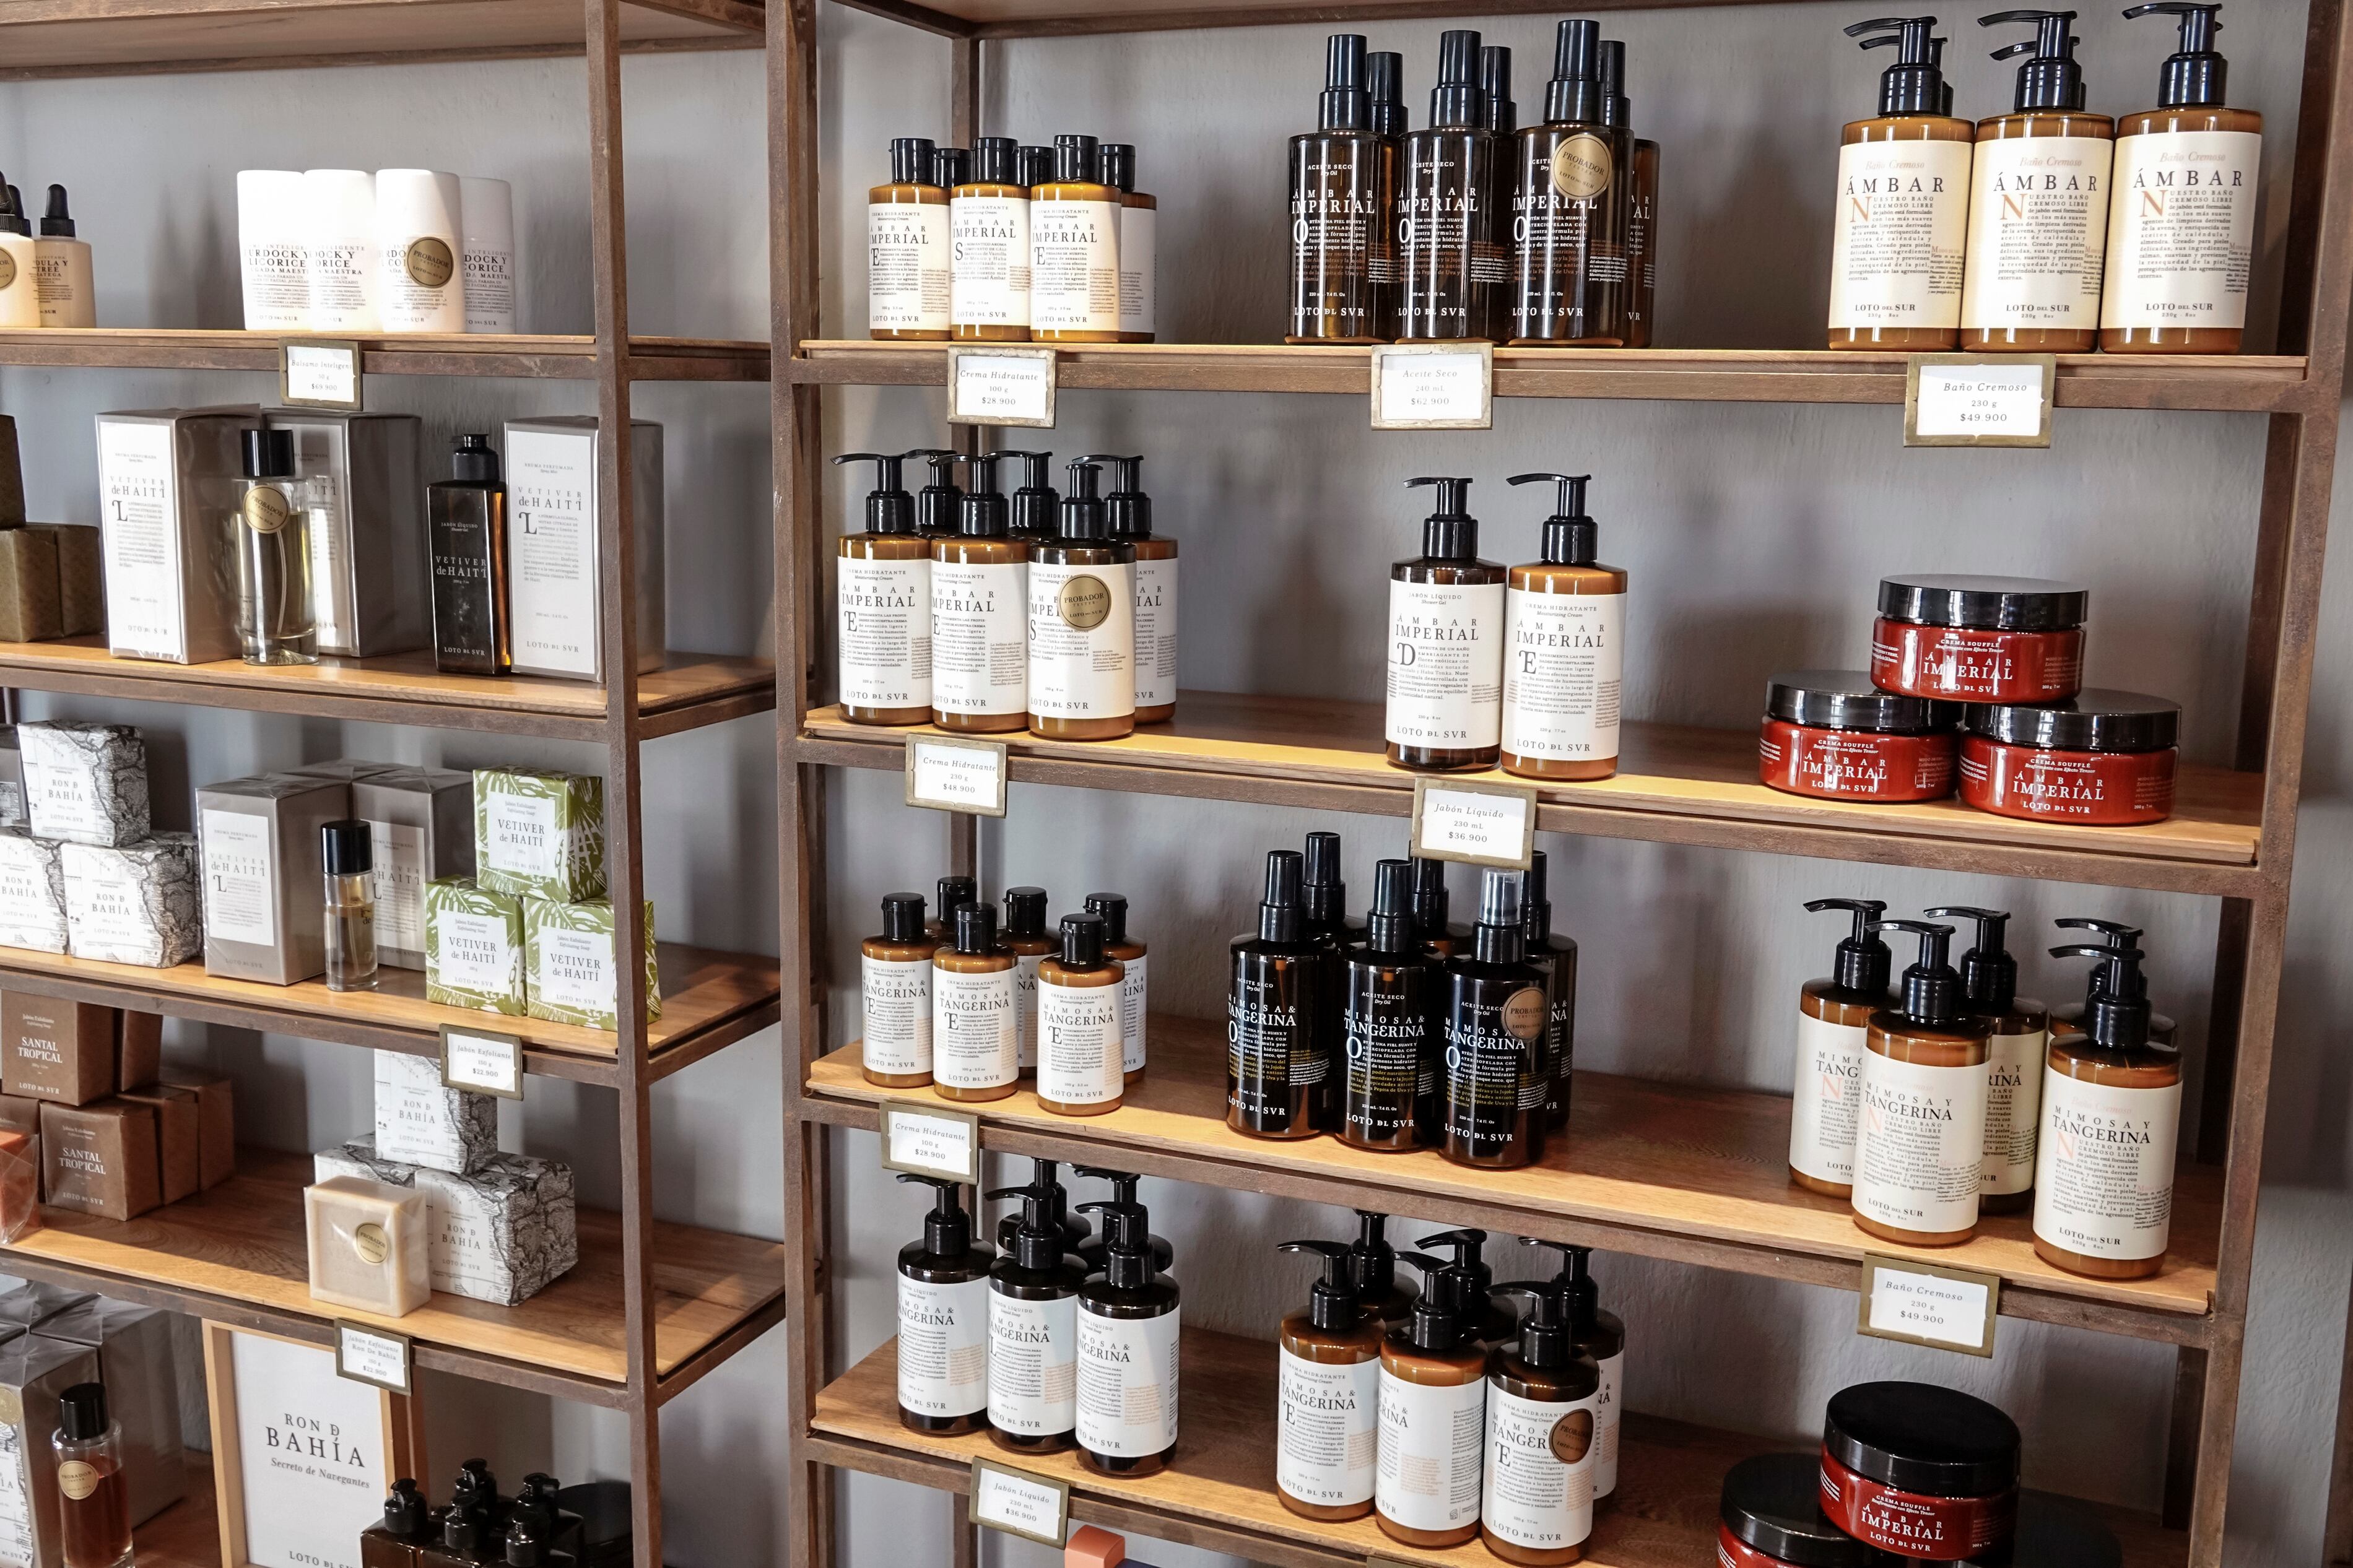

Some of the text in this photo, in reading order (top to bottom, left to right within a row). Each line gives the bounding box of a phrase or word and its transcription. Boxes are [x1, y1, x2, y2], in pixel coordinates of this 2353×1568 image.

[1562, 150, 1605, 176] PROBADOR
[2046, 157, 2082, 167] Cremoso
[2160, 151, 2225, 162] Baño Cremoso
[1889, 160, 1925, 170] Cremoso
[1846, 176, 1944, 195] ÁMBAR
[1993, 172, 2097, 192] ÁMBAR
[2133, 168, 2242, 188] ÁMBAR
[1292, 200, 1375, 214] IMPERIAL
[1398, 198, 1479, 214] IMPERIAL
[1513, 196, 1598, 212] IMPERIAL
[870, 233, 929, 245] IMPERIAL
[953, 228, 1016, 238] IMPERIAL
[1033, 232, 1097, 243] IMPERIAL
[413, 250, 450, 267] PROBADOR
[2006, 304, 2069, 312] LOTO SUR
[960, 370, 1038, 381] Crema Hidratante
[1403, 370, 1458, 378] Aceite Seco
[1944, 383, 2027, 392] Baño Cremoso
[518, 487, 581, 498] VETIVER
[436, 555, 487, 566] VETIVER
[842, 592, 916, 607] IMPERIAL
[1064, 592, 1105, 604] PROBADOR
[1396, 623, 1479, 641] IMPERIAL
[1516, 630, 1604, 648] IMPERIAL
[846, 690, 868, 700] LOTO
[1397, 726, 1423, 737] LOTO
[1516, 738, 1546, 750] LOTO
[1818, 739, 1842, 747] CREMA
[923, 756, 997, 772] Crema Hidratante
[1803, 760, 1887, 780] IMPERIAL
[2030, 758, 2056, 766] CREMA
[2012, 780, 2104, 800] IMPERIAL
[1434, 803, 1504, 818] Jabón Líquido
[2023, 801, 2051, 811] LOTO
[498, 818, 545, 835] VETIVER
[500, 833, 508, 842] de
[449, 936, 497, 952] VETIVER
[451, 951, 461, 959] de
[550, 953, 601, 970] VETIVER
[552, 969, 562, 977] de
[1362, 991, 1386, 1000] ACEITE
[1044, 1003, 1103, 1015] MIMOSA
[1345, 1008, 1412, 1025] MIMOSA
[1043, 1011, 1114, 1026] TANGERINA
[1344, 1016, 1425, 1037] TANGERINA
[22, 1036, 59, 1053] SANTAL
[1444, 1026, 1526, 1050] TANGERINA
[18, 1047, 63, 1064] TROPICAL
[1051, 1089, 1072, 1098] LOTO
[1866, 1081, 1933, 1107] MIMOSA
[1864, 1089, 1952, 1121] TANGERINA
[1346, 1112, 1373, 1126] LOTO
[2055, 1105, 2131, 1129] MIMOSA
[895, 1122, 966, 1141] Crema Hidratante
[1444, 1122, 1470, 1138] LOTO
[2053, 1114, 2151, 1145] TANGERINA
[63, 1147, 102, 1164] SANTAL
[59, 1156, 107, 1176] TROPICAL
[1868, 1197, 1923, 1218] LOTO SUR
[2059, 1226, 2121, 1246] LOTO SUR
[1885, 1280, 1964, 1301] Baño Cremoso
[1910, 1300, 1927, 1309] 230
[284, 1413, 321, 1432] RON
[266, 1426, 366, 1468] BAHÍA
[271, 1457, 370, 1489] Secreto de Navegantes
[993, 1483, 1051, 1504] Jabón Líquido
[1876, 1494, 1899, 1506] CREMA
[1010, 1498, 1022, 1507] 230
[1493, 1520, 1519, 1537] LOTO
[1861, 1510, 1944, 1541] IMPERIAL
[1870, 1531, 1895, 1546] LOTO
[289, 1551, 320, 1566] LOTO
